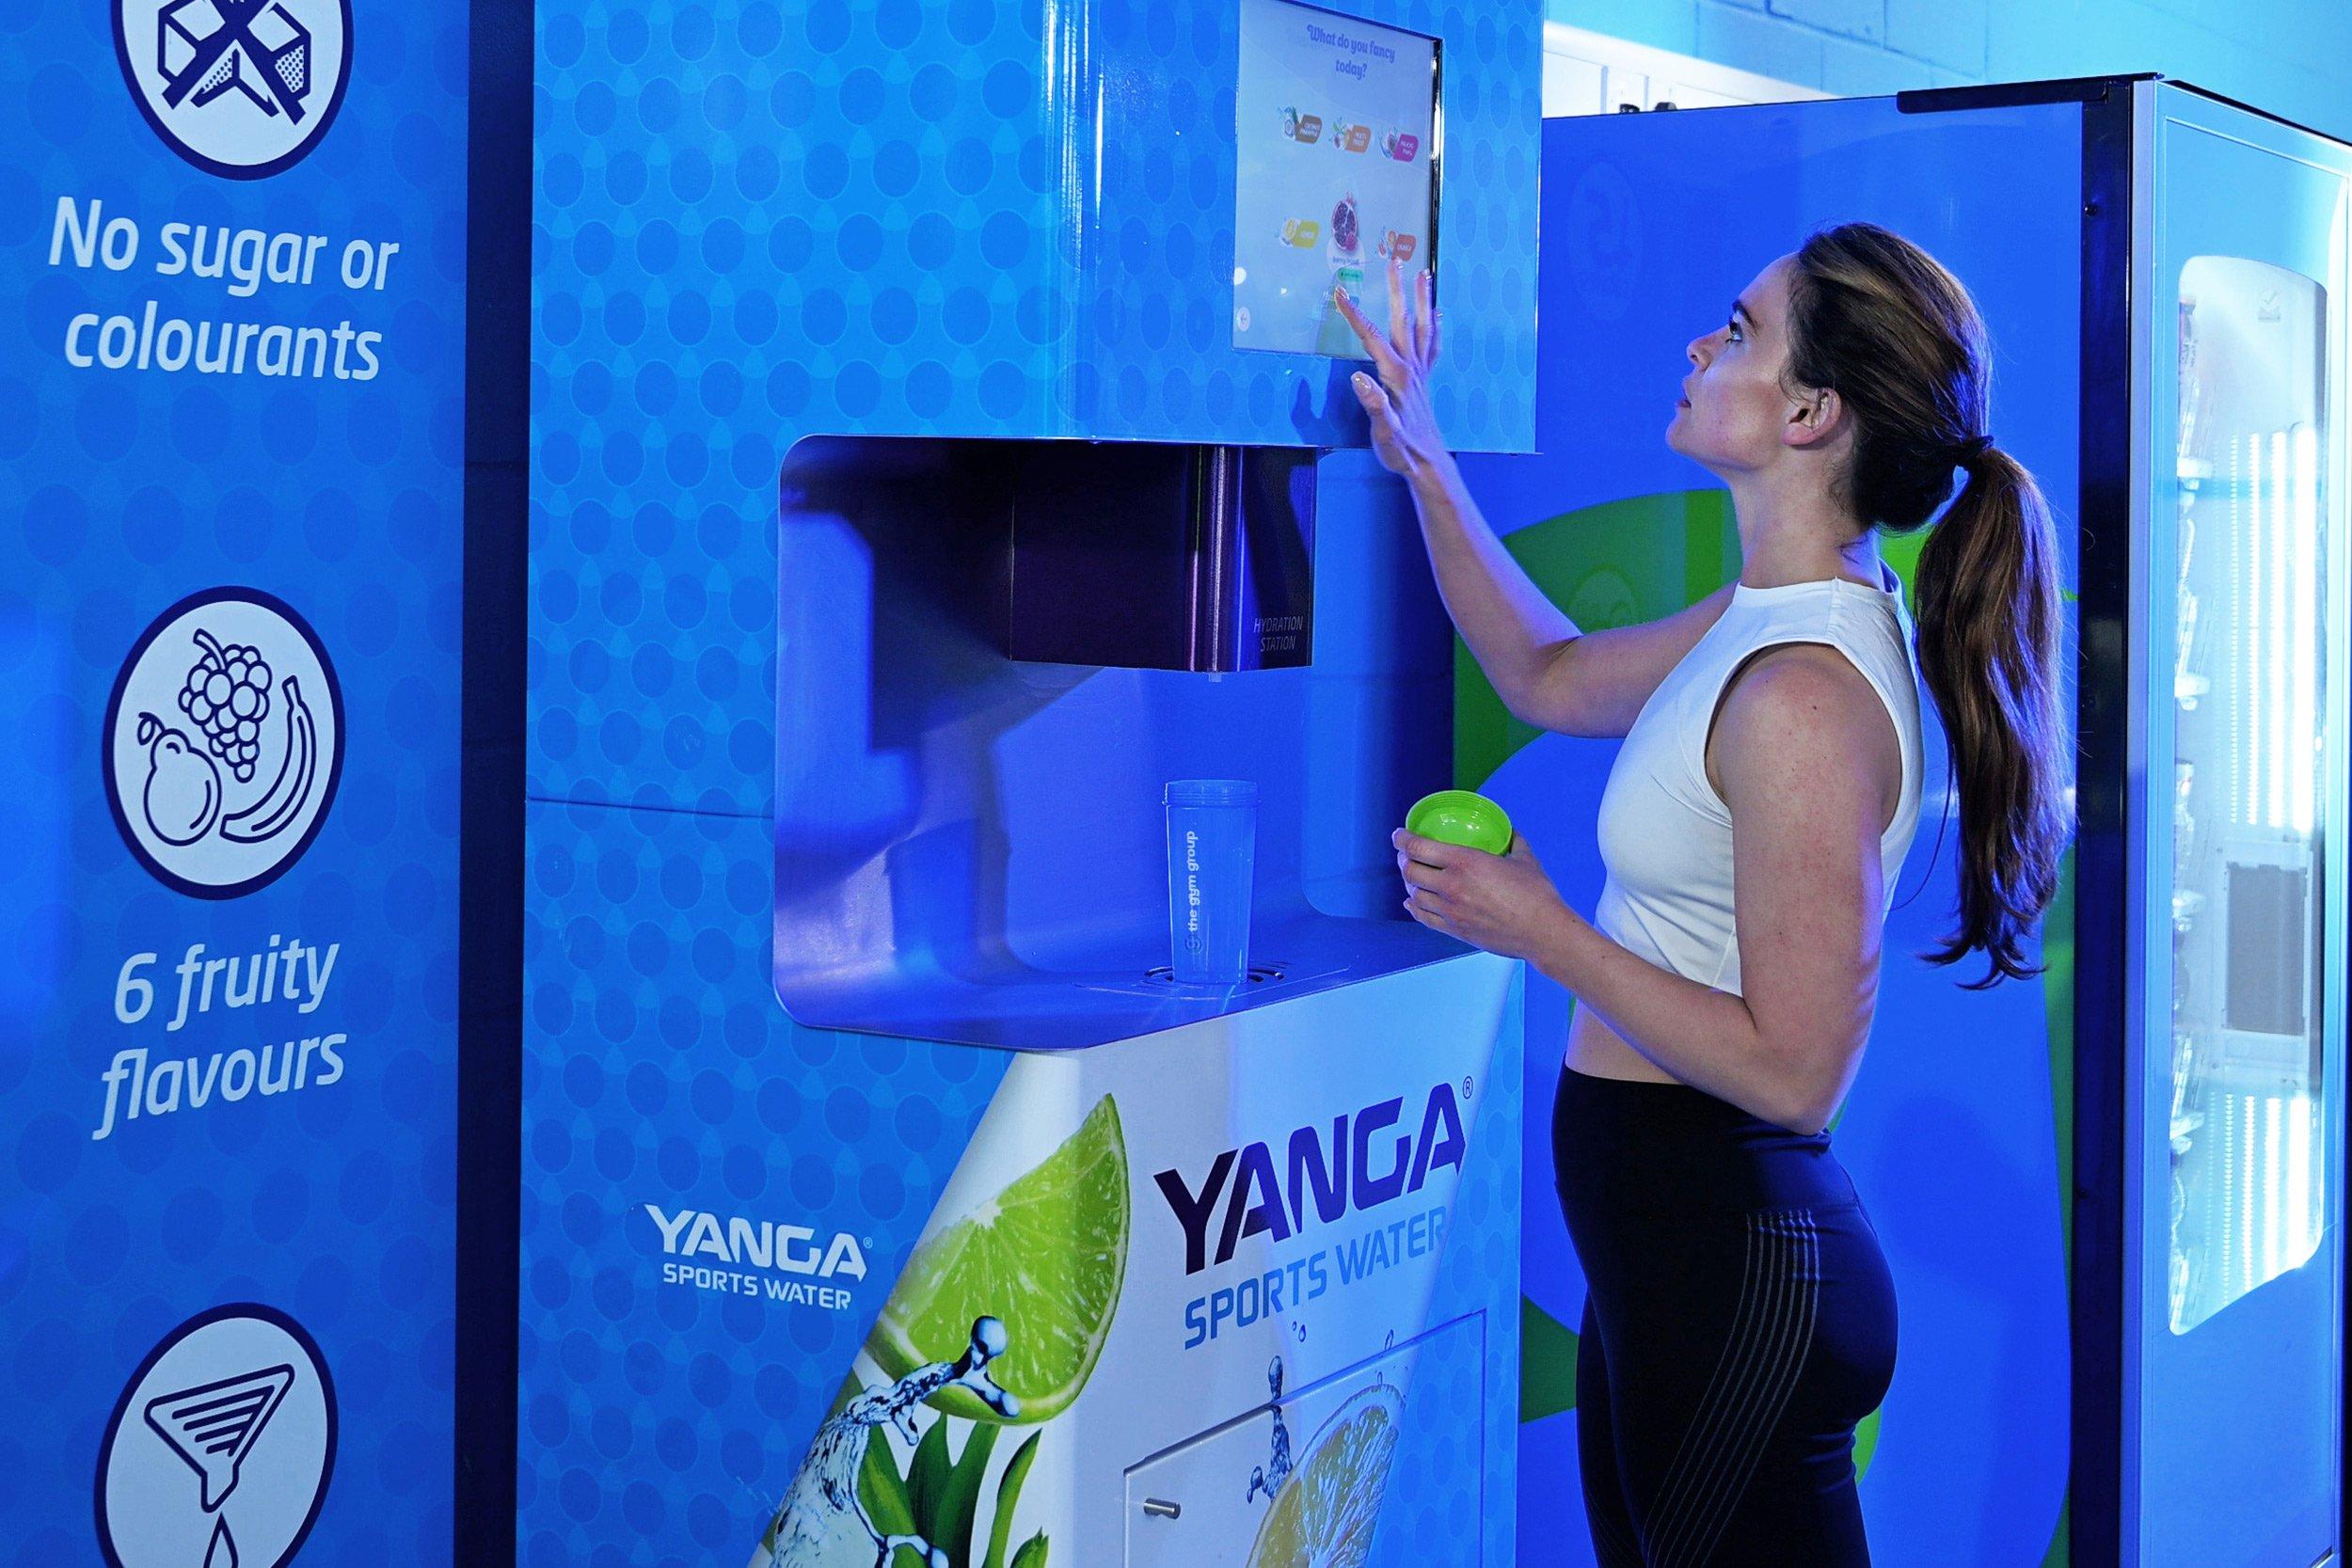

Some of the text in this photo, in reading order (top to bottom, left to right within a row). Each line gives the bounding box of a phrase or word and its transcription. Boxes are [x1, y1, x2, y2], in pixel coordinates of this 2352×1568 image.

[1307, 24, 1395, 63] What do you fancy
[1336, 59, 1367, 80] today?
[48, 196, 400, 297] No sugar or
[64, 299, 383, 381] colourants
[1253, 615, 1304, 633] HYDRATION
[1260, 635, 1296, 653] STATION
[1186, 831, 1200, 932] the gym group
[114, 934, 341, 1032] 6 fruity
[91, 1033, 347, 1141] flavours
[663, 1263, 851, 1310] SPORTS WATER
[1184, 1206, 1449, 1351] SPORTS WATER
